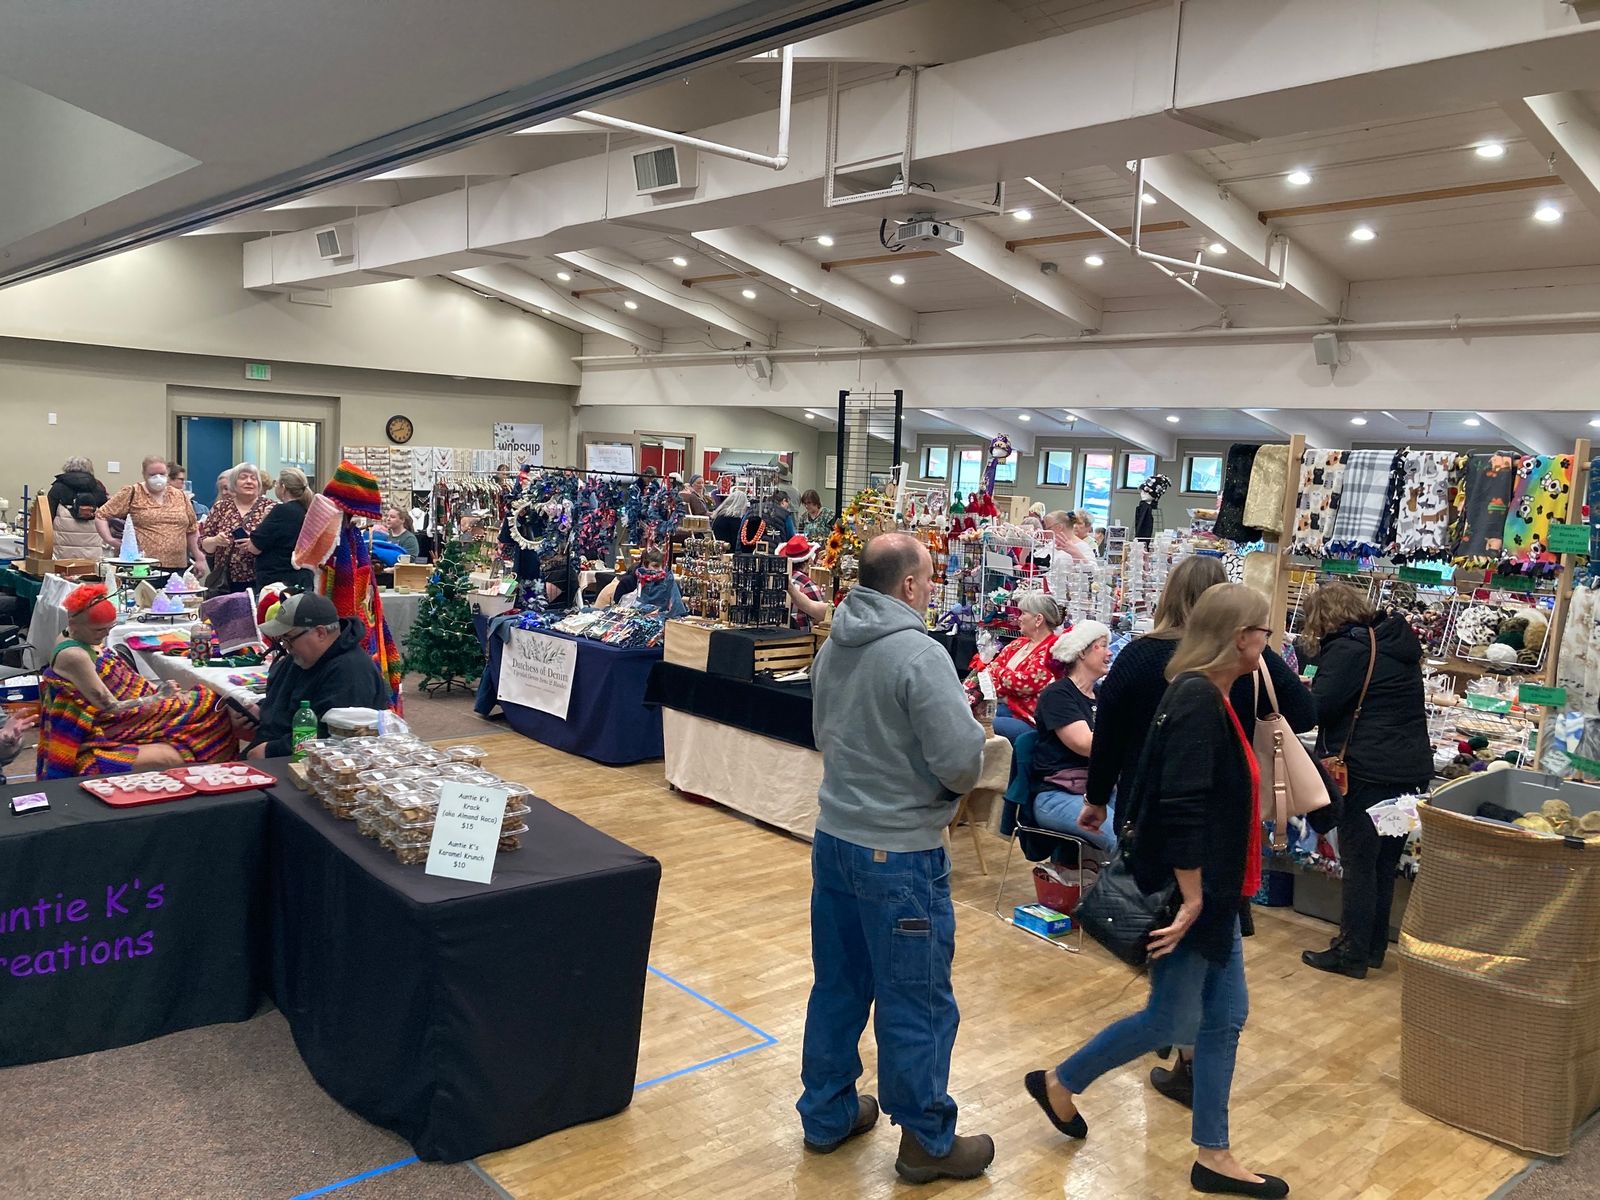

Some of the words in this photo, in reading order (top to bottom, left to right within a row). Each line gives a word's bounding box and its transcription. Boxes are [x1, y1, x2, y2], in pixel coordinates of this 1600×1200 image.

[498, 443, 540, 455] WORSHIP
[512, 658, 538, 673] Dutchess
[540, 666, 546, 676] of
[547, 668, 568, 682] Denim
[463, 803, 480, 811] Krack
[457, 812, 479, 821] Almond
[480, 815, 498, 825] Roca)
[461, 822, 474, 830] $15
[447, 840, 467, 849] Auntie
[468, 843, 480, 851] K's
[438, 849, 462, 858] Karamel
[463, 853, 485, 861] Krunch
[453, 861, 466, 869] $10
[106, 878, 165, 918] K's
